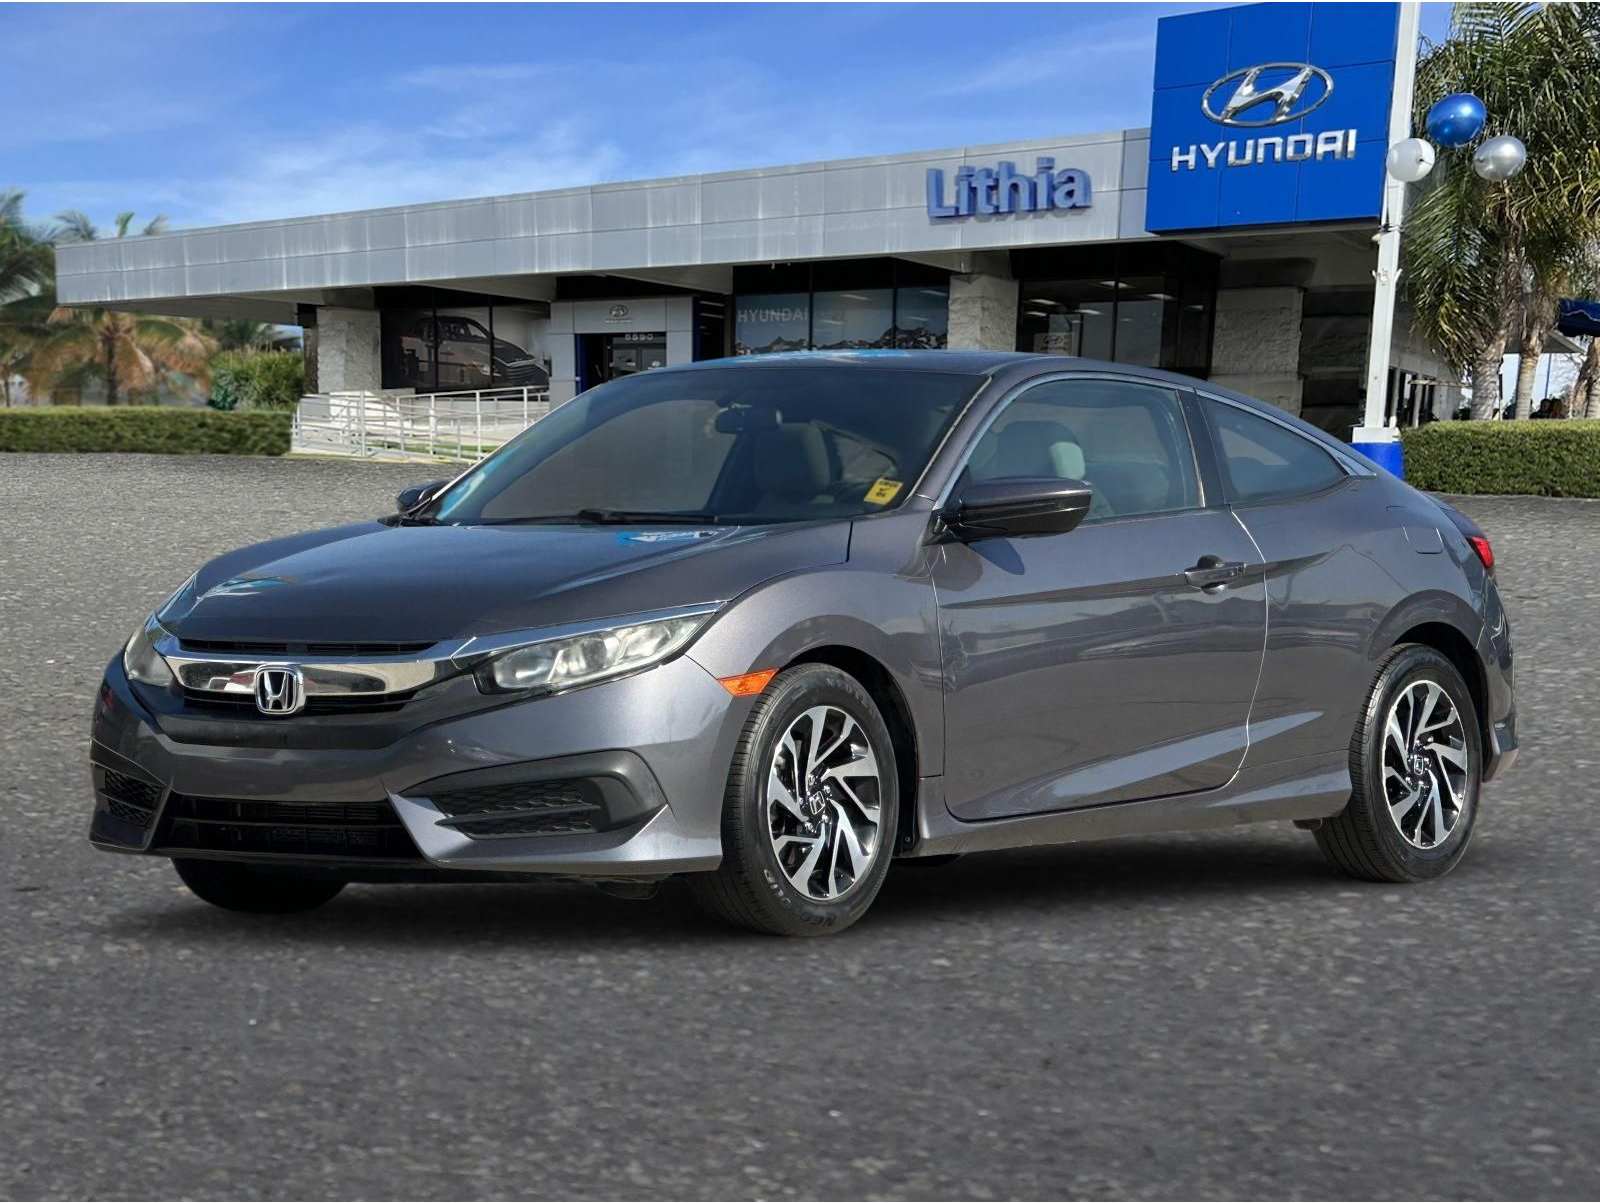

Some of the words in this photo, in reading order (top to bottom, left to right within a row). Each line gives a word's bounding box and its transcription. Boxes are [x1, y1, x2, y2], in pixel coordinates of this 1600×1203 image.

[1172, 129, 1357, 171] HYUNDAI
[926, 156, 1093, 219] Lithia
[737, 308, 809, 323] HYUNDAI
